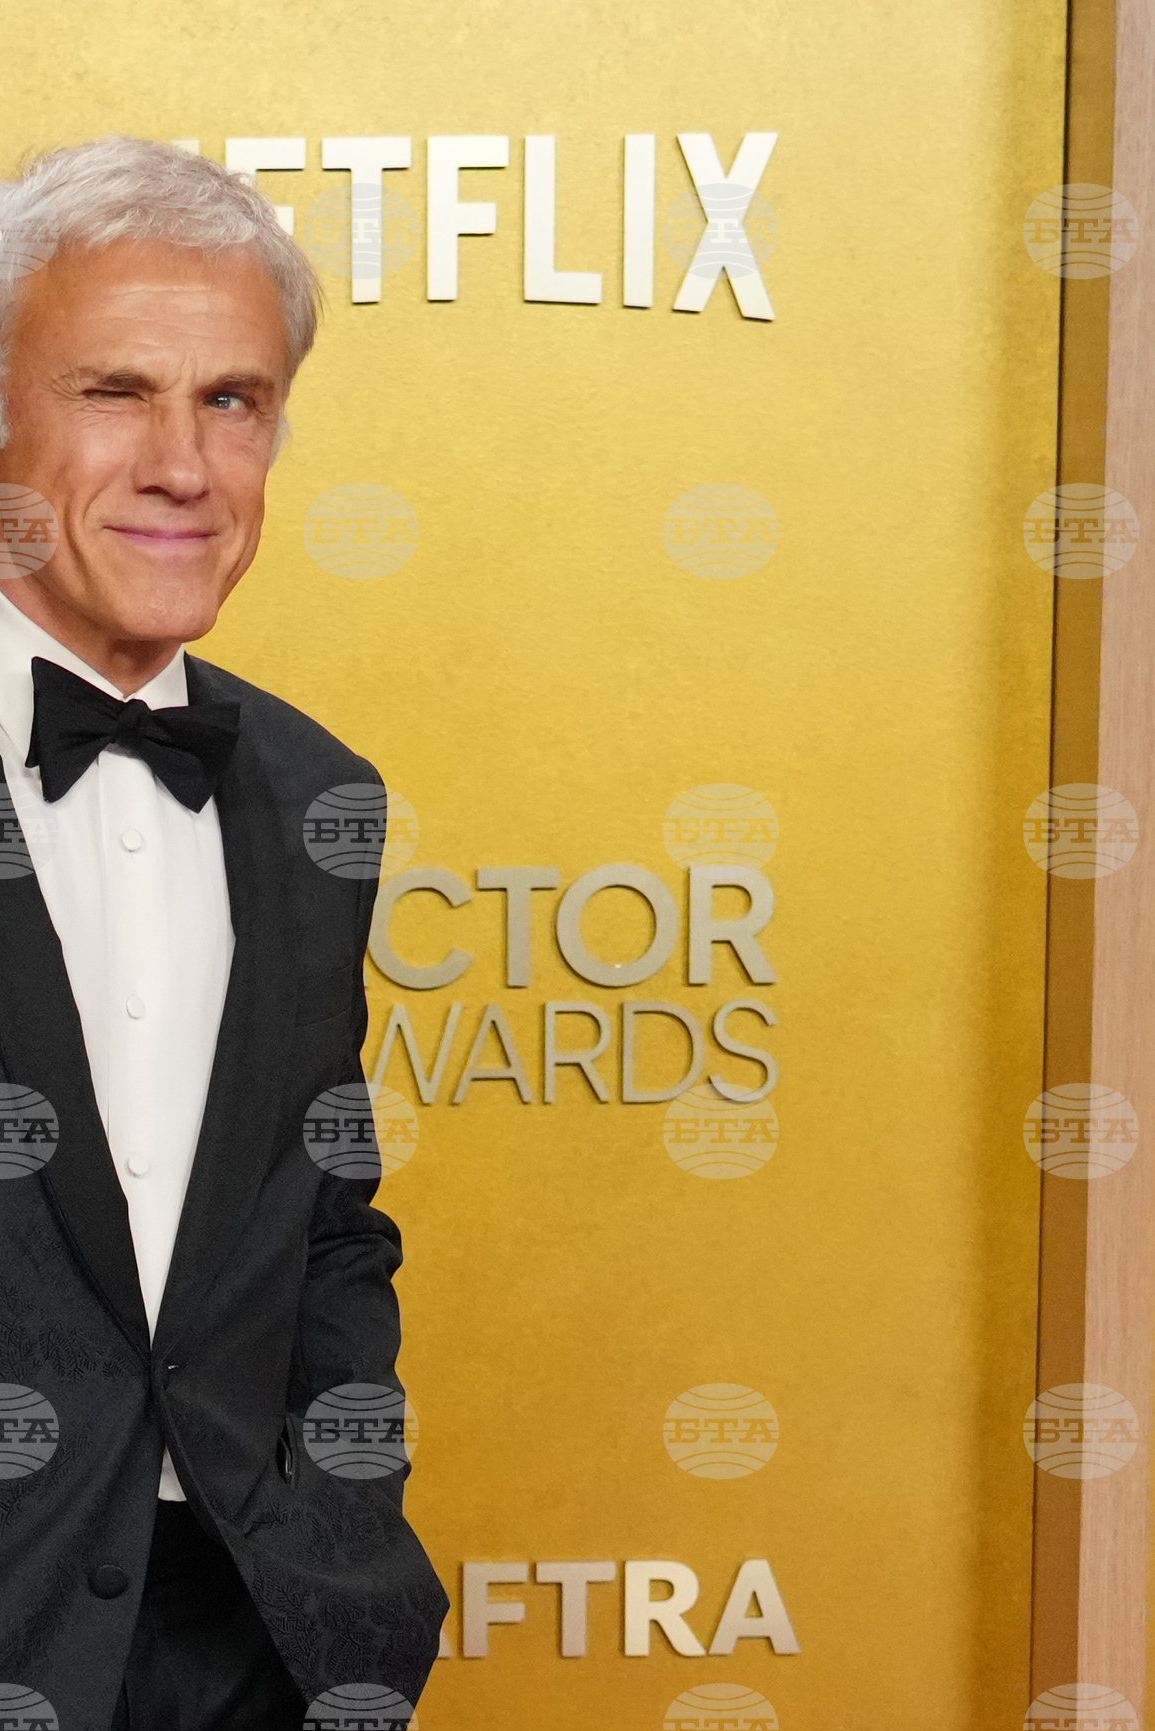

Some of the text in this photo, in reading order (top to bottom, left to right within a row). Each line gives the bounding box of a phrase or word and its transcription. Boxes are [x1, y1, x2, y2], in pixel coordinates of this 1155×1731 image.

[171, 131, 779, 321] TFLIX
[363, 864, 777, 992] CTOR
[369, 1000, 779, 1107] WARDS
[438, 1558, 802, 1658] FTRA
